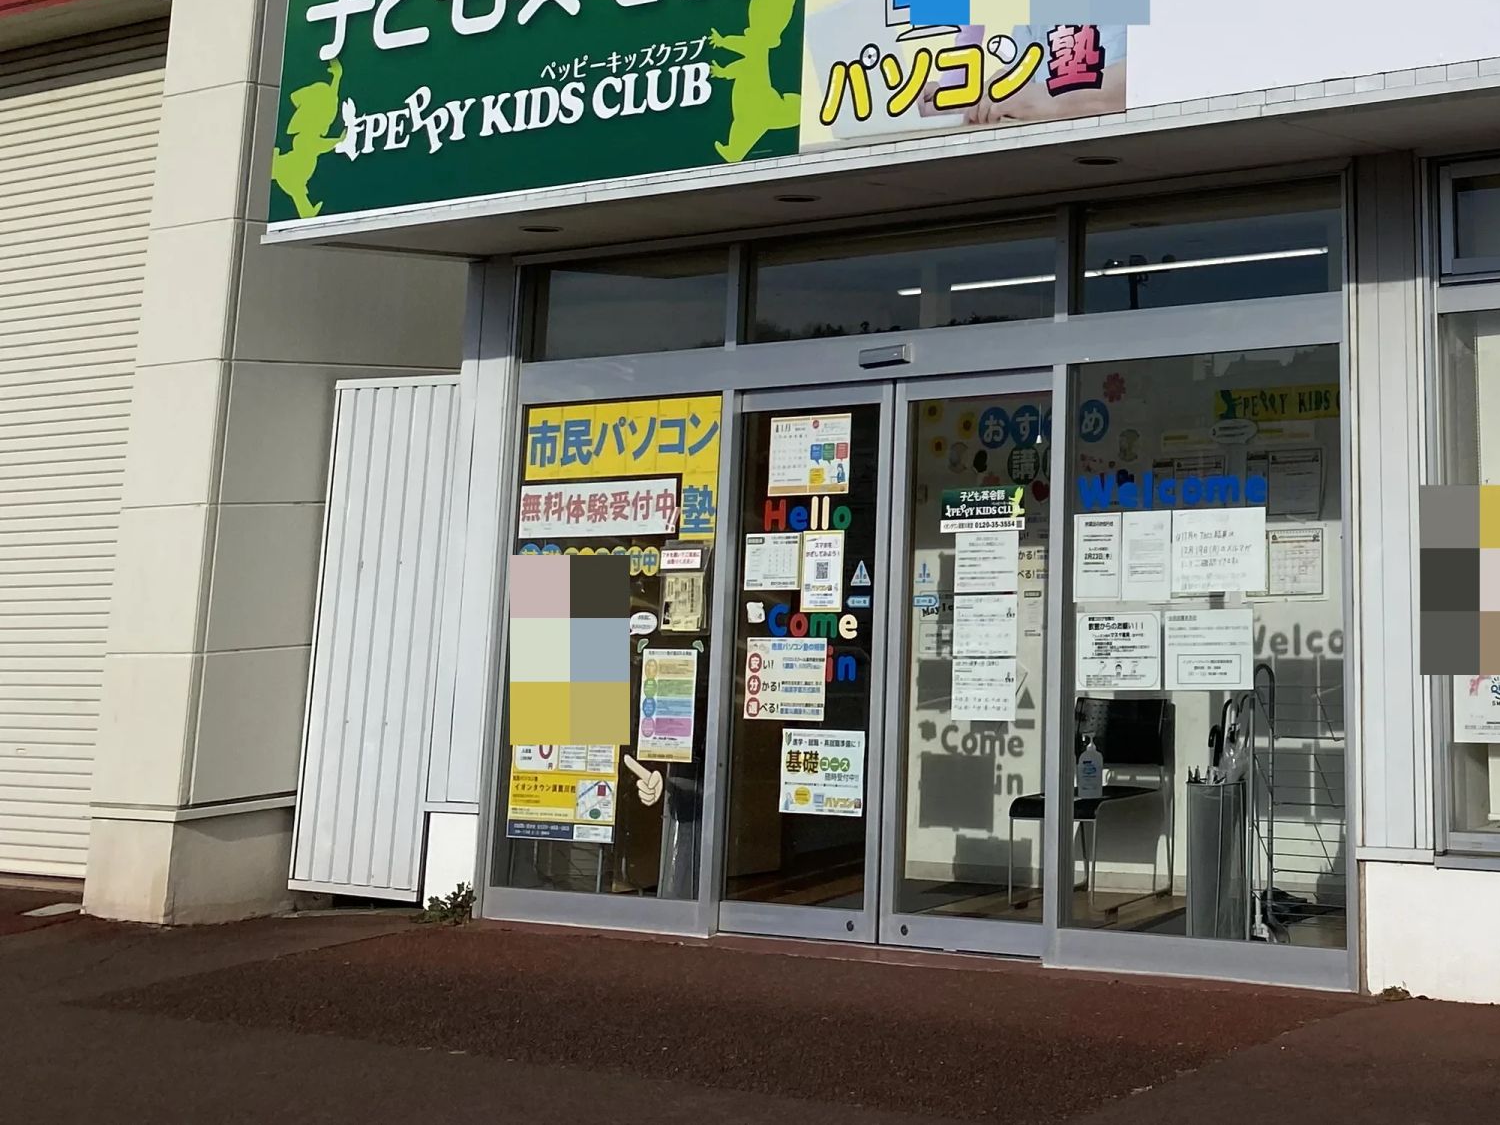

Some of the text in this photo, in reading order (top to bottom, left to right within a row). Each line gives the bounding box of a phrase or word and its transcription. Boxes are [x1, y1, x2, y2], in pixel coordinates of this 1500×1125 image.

[540, 35, 708, 81] ペッピーキッズクラブ
[819, 24, 1105, 126] パソコン塾
[360, 61, 713, 155] PEPPY KIDS CLUB
[1298, 388, 1331, 415] KIDS
[528, 413, 720, 468] 市民パソコン
[679, 484, 716, 533] 塾
[959, 489, 1005, 502] 子ども英会話
[1078, 470, 1267, 510] Welcome
[763, 495, 852, 532] Hello
[949, 504, 1020, 518] PEPPY KIDS CLU
[768, 603, 858, 640] Come
[826, 644, 857, 683] in
[785, 749, 850, 774] 基礎 コース
